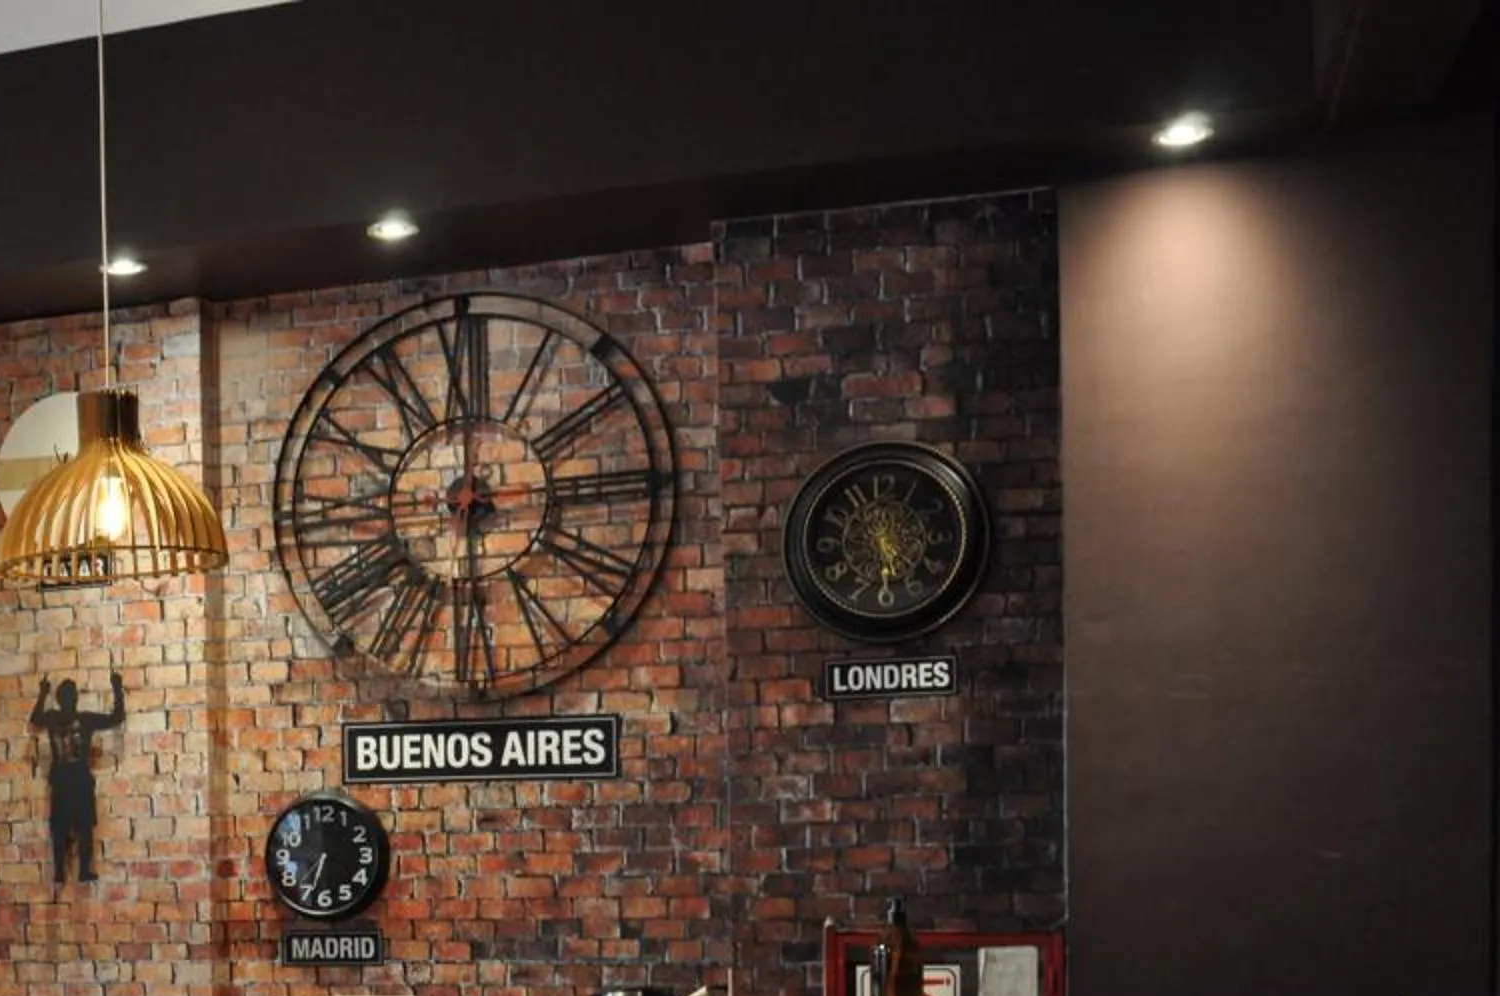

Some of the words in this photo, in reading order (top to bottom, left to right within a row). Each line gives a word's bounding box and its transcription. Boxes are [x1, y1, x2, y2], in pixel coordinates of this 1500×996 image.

[832, 661, 950, 692] LONDRES
[355, 732, 493, 771] BUENOS
[500, 728, 606, 768] AIRES
[313, 805, 336, 823] 12
[340, 811, 348, 827] 1
[281, 831, 301, 847] 10
[352, 826, 367, 843] 2
[276, 849, 290, 866] 9
[359, 847, 373, 864] 3
[282, 869, 298, 887] 8
[352, 868, 369, 886] 4
[300, 884, 314, 901] 7
[317, 889, 332, 907] 6
[339, 884, 353, 901] 5
[291, 937, 375, 960] MADRID
